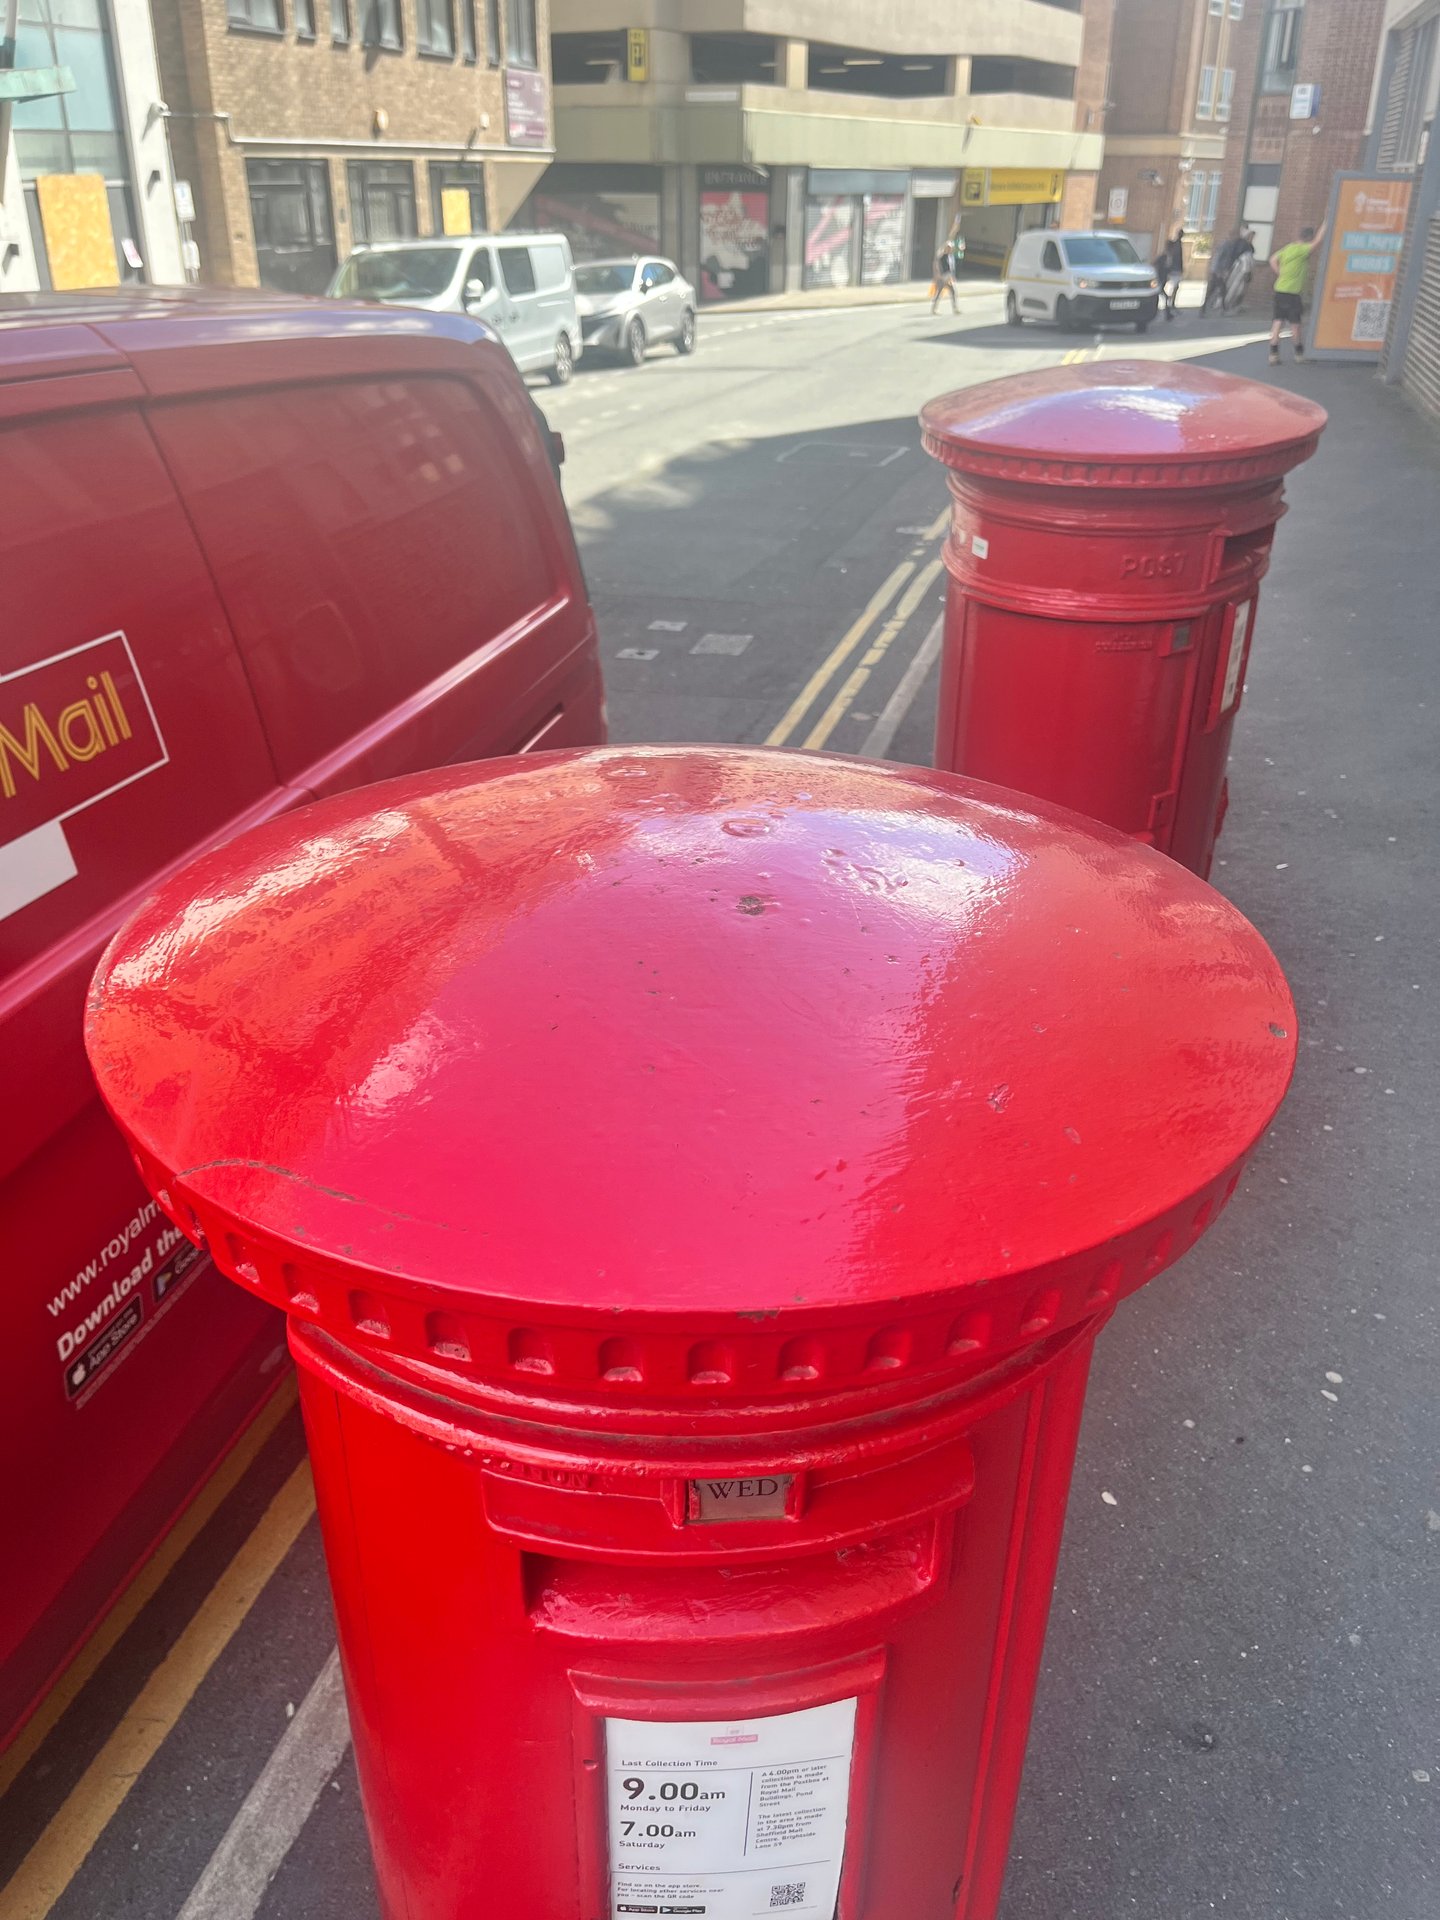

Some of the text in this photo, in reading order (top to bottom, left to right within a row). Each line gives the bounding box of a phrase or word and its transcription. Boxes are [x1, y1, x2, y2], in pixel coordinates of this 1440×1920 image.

[1120, 551, 1187, 579] POST
[0, 671, 132, 798] Mail
[56, 1246, 154, 1362] Download
[706, 1478, 779, 1500] WED
[622, 1777, 726, 1801] 9.00am
[620, 1804, 661, 1812] Monday
[678, 1804, 711, 1812] Friday
[620, 1820, 696, 1837] 7.00am
[619, 1840, 666, 1850] Saturday
[618, 1863, 661, 1871] Services
